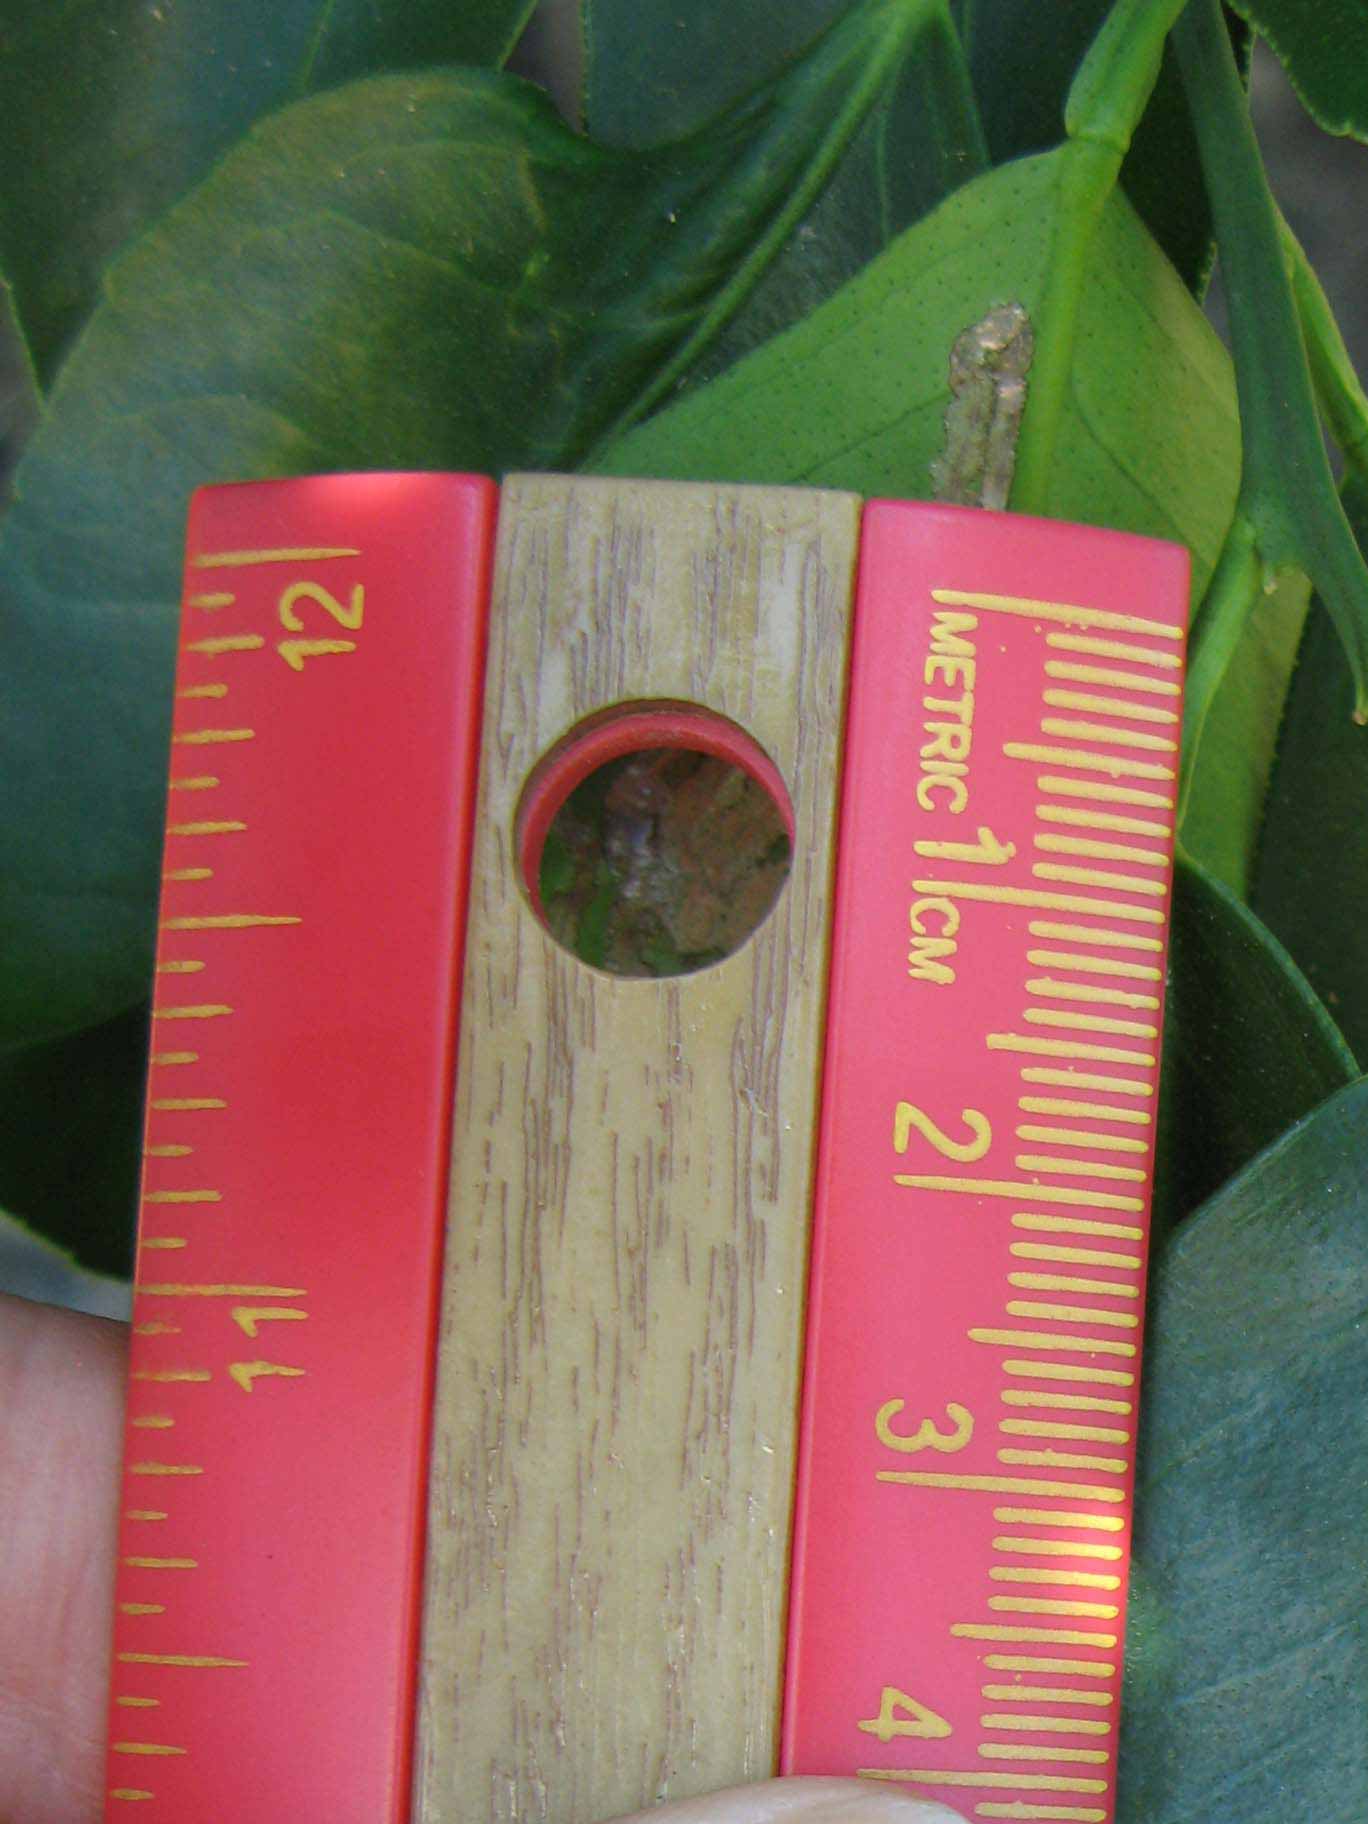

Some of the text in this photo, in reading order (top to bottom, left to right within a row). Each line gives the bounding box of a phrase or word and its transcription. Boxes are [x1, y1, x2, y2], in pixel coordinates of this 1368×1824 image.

[278, 581, 365, 672] 12
[907, 611, 1017, 985] METRIC 1 CM
[893, 1101, 993, 1163] 2
[229, 1306, 309, 1393] 11
[874, 1397, 975, 1454] 3
[856, 1685, 953, 1743] 4
